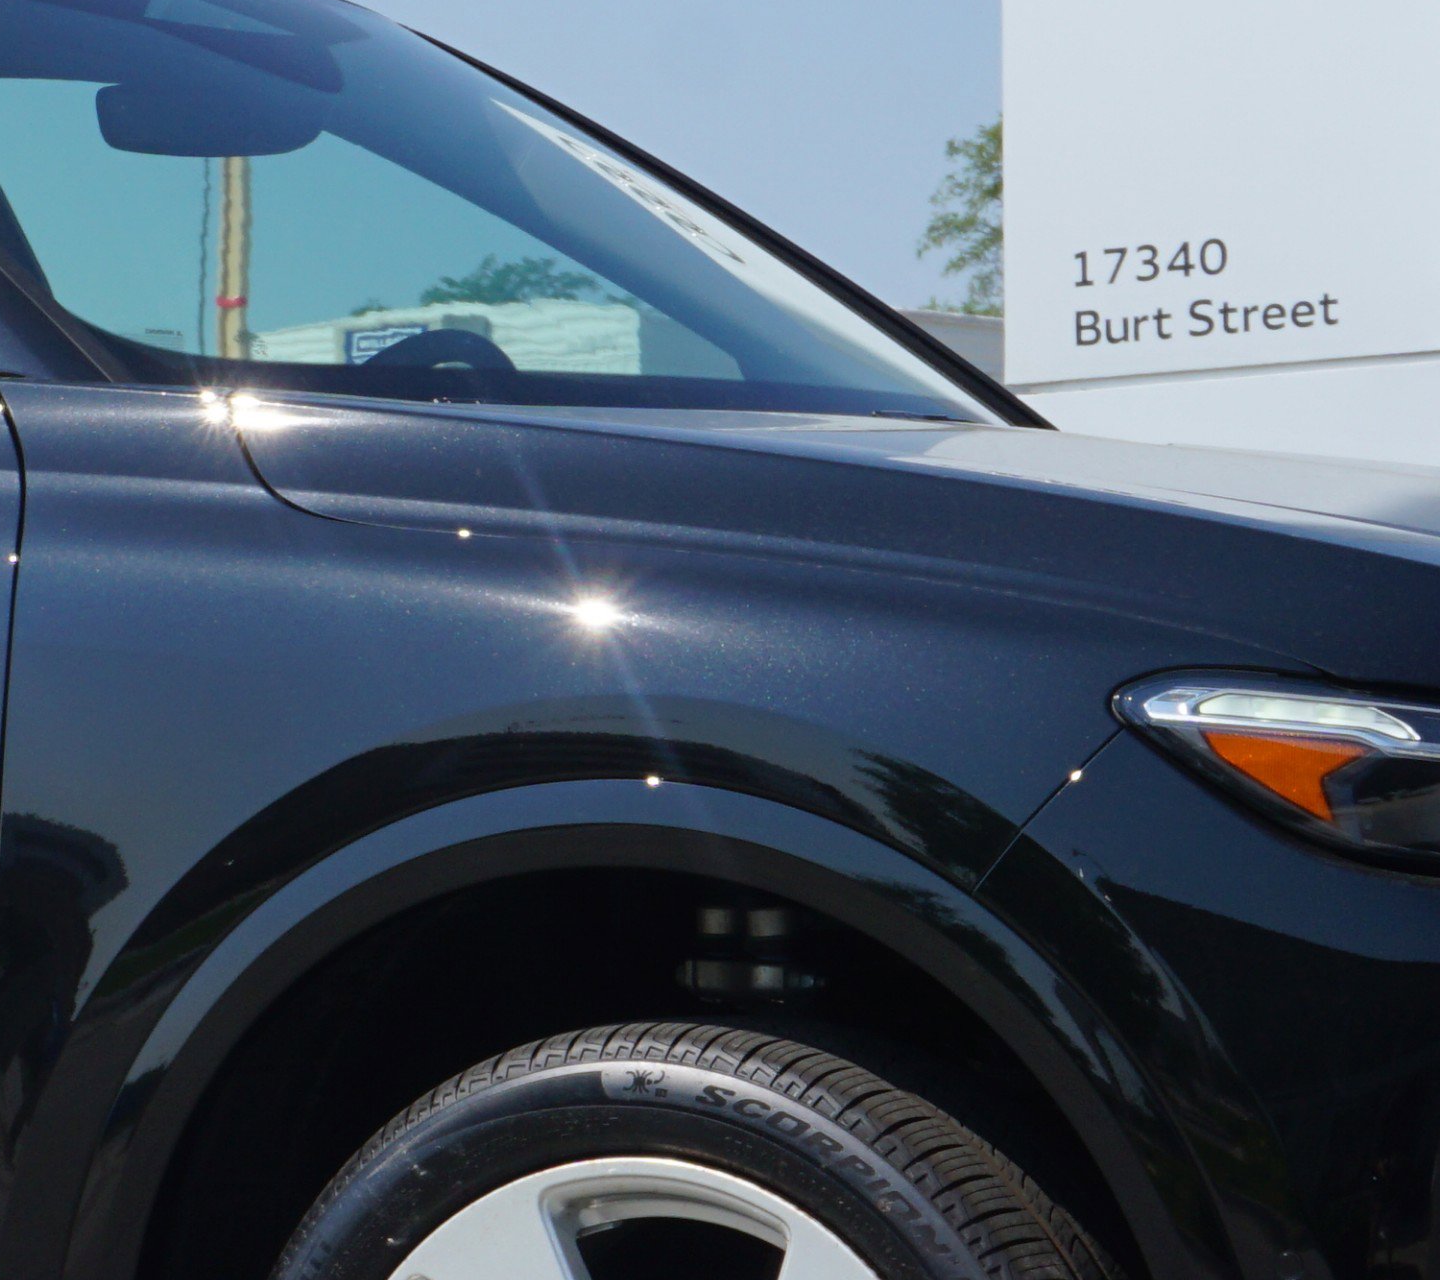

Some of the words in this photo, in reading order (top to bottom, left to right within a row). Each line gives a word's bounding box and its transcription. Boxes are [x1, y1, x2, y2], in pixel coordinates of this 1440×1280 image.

[1074, 237, 1229, 288] 17340
[1074, 306, 1172, 348] Burt
[1188, 292, 1340, 335] Street
[694, 1084, 952, 1257] SCORPION
